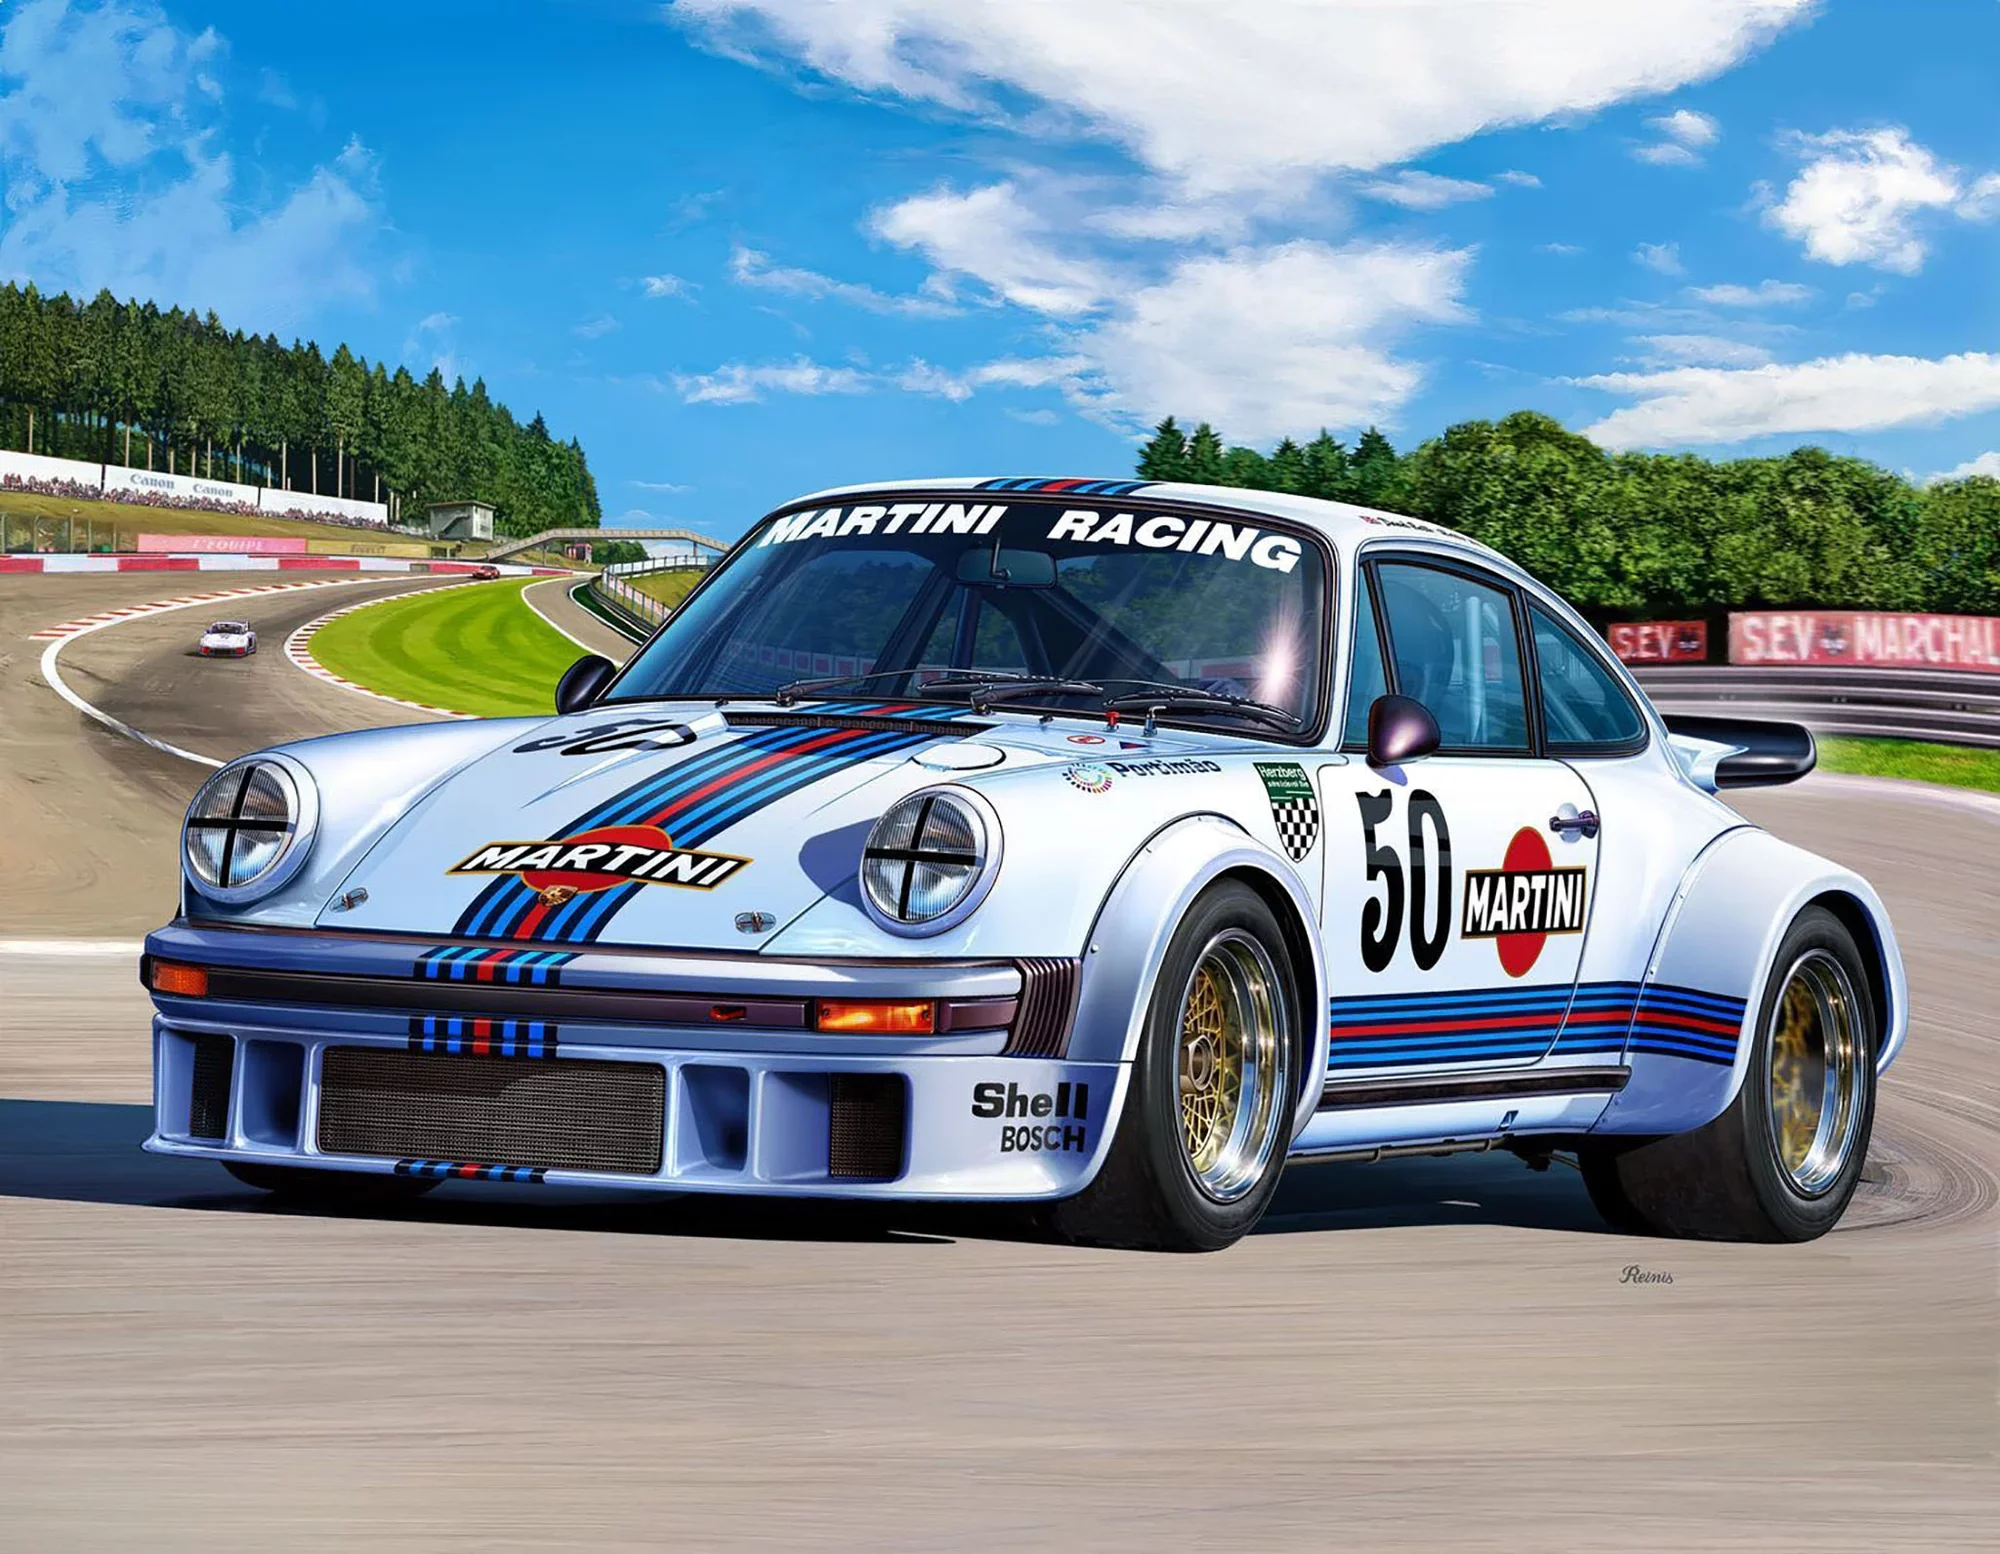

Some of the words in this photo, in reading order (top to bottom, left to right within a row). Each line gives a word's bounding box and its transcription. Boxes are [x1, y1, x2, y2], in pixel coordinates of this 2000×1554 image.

[130, 473, 175, 490] Canon
[193, 484, 233, 498] Canon
[757, 503, 1008, 549] MARTINI
[1047, 511, 1302, 574] RACING
[1855, 616, 2000, 666] MARCHAL
[513, 719, 697, 756] 50
[461, 844, 739, 886] MARTINI
[1355, 788, 1453, 973] 50
[1465, 874, 1583, 933] MARTINI
[972, 1082, 1089, 1120] Shell
[1000, 1125, 1086, 1152] BOSCH
[1619, 1264, 1674, 1285] Reinis
